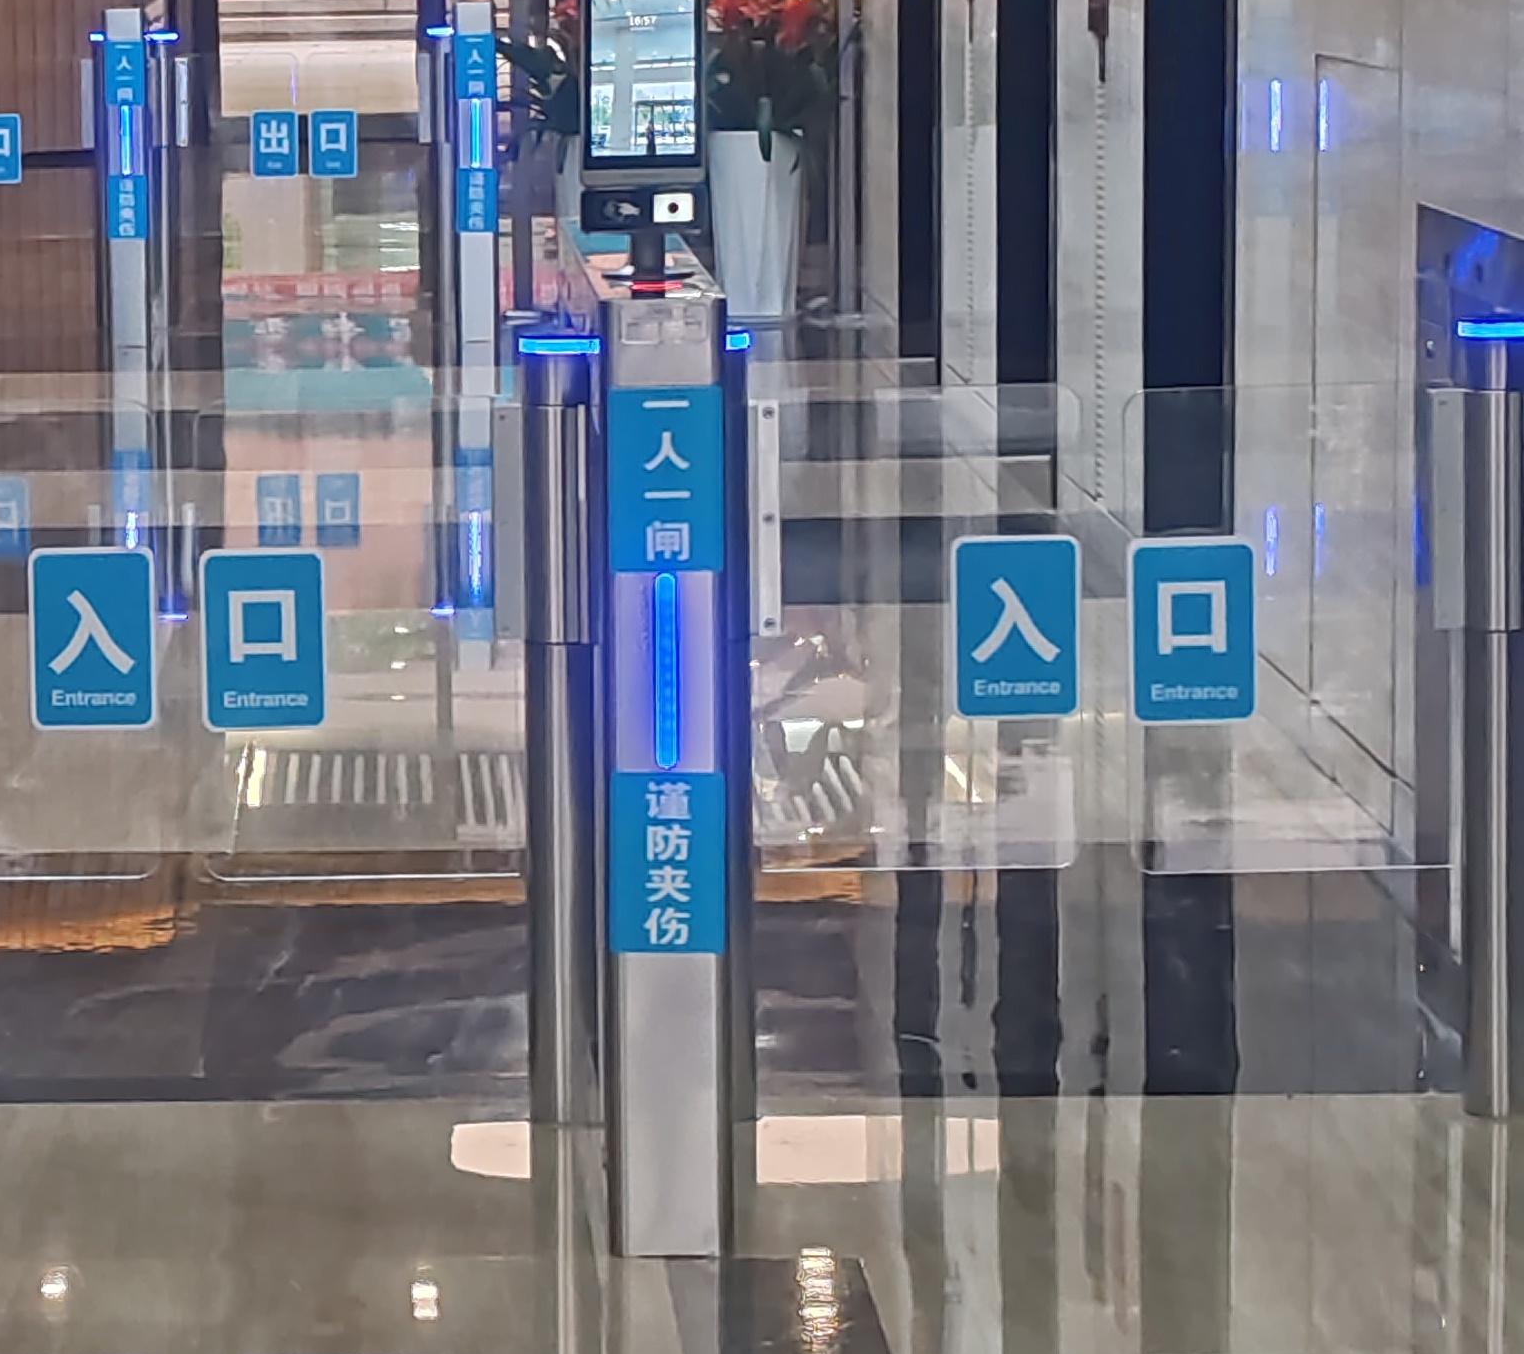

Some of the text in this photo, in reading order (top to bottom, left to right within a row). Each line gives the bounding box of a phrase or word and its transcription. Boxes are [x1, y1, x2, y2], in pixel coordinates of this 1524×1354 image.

[643, 399, 691, 562] 一人一闸
[48, 589, 298, 675] 入 口
[971, 578, 1228, 663] 入 口
[52, 689, 137, 707] Entrance
[224, 690, 309, 709] Entrance
[974, 679, 1061, 696] Entrance
[1151, 683, 1239, 702] Entrance
[644, 781, 692, 945] 谨防夹伤
